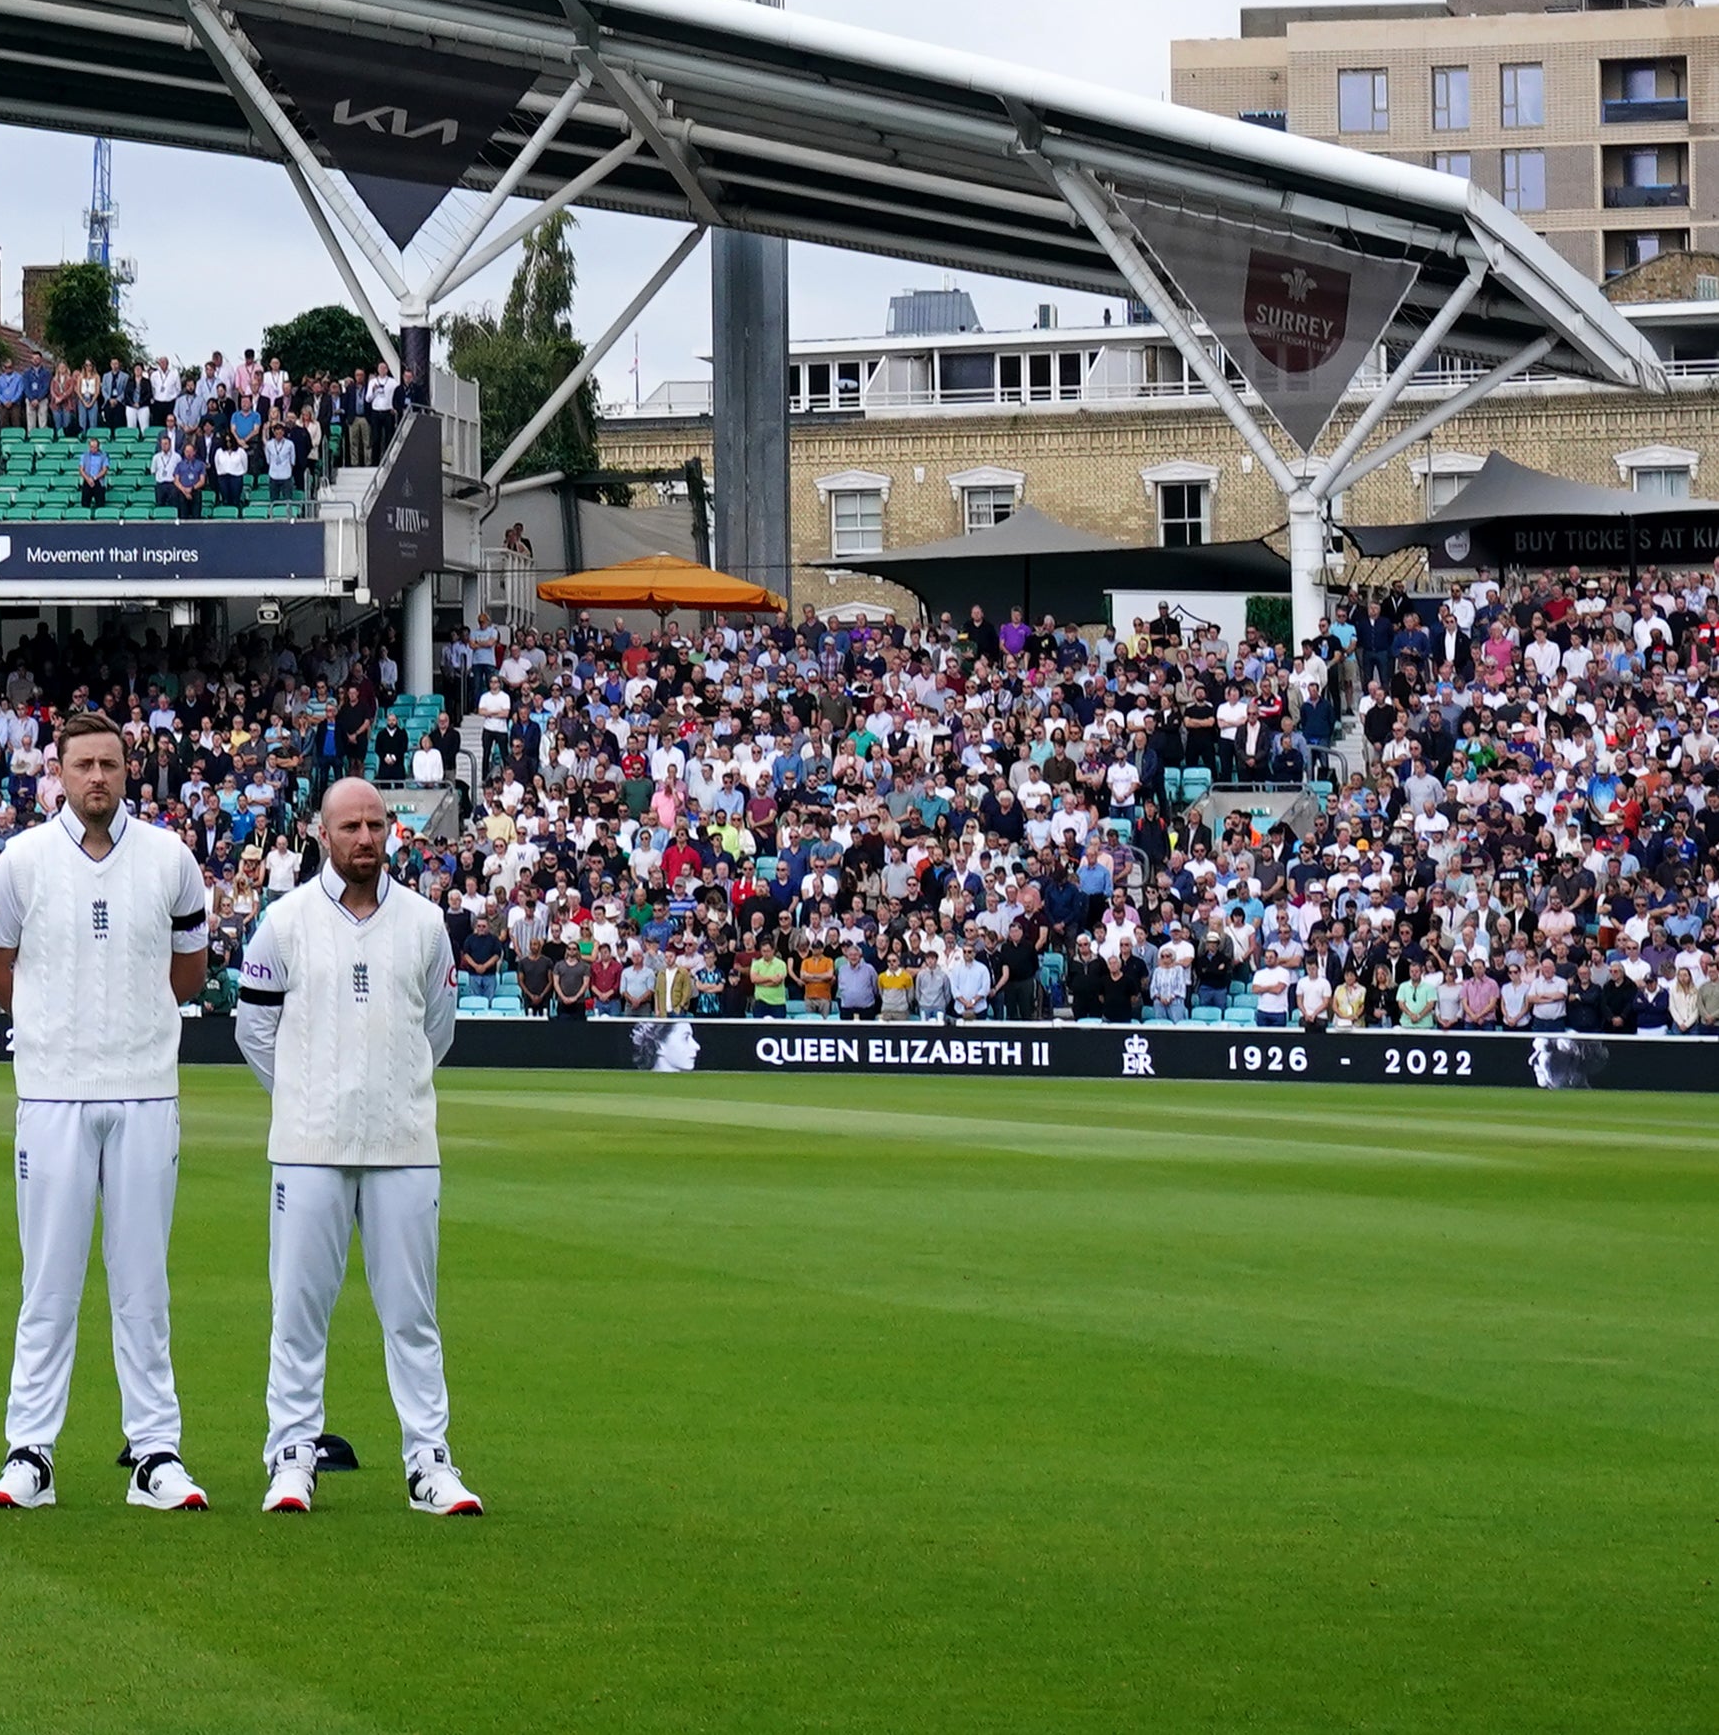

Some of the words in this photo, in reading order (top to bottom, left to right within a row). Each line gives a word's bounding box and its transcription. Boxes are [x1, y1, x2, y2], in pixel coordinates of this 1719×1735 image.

[1256, 304, 1334, 340] SURREY
[1514, 531, 1557, 552] BUY
[1660, 528, 1686, 549] AT
[26, 547, 106, 564] Movement
[109, 547, 139, 565] that
[143, 548, 199, 569] inspires
[756, 1037, 859, 1065] QUEEN
[868, 1039, 1022, 1066] ELIZABETH
[1032, 1042, 1049, 1066] II
[1228, 1045, 1308, 1072] 1926
[1385, 1049, 1473, 1075] 2022
